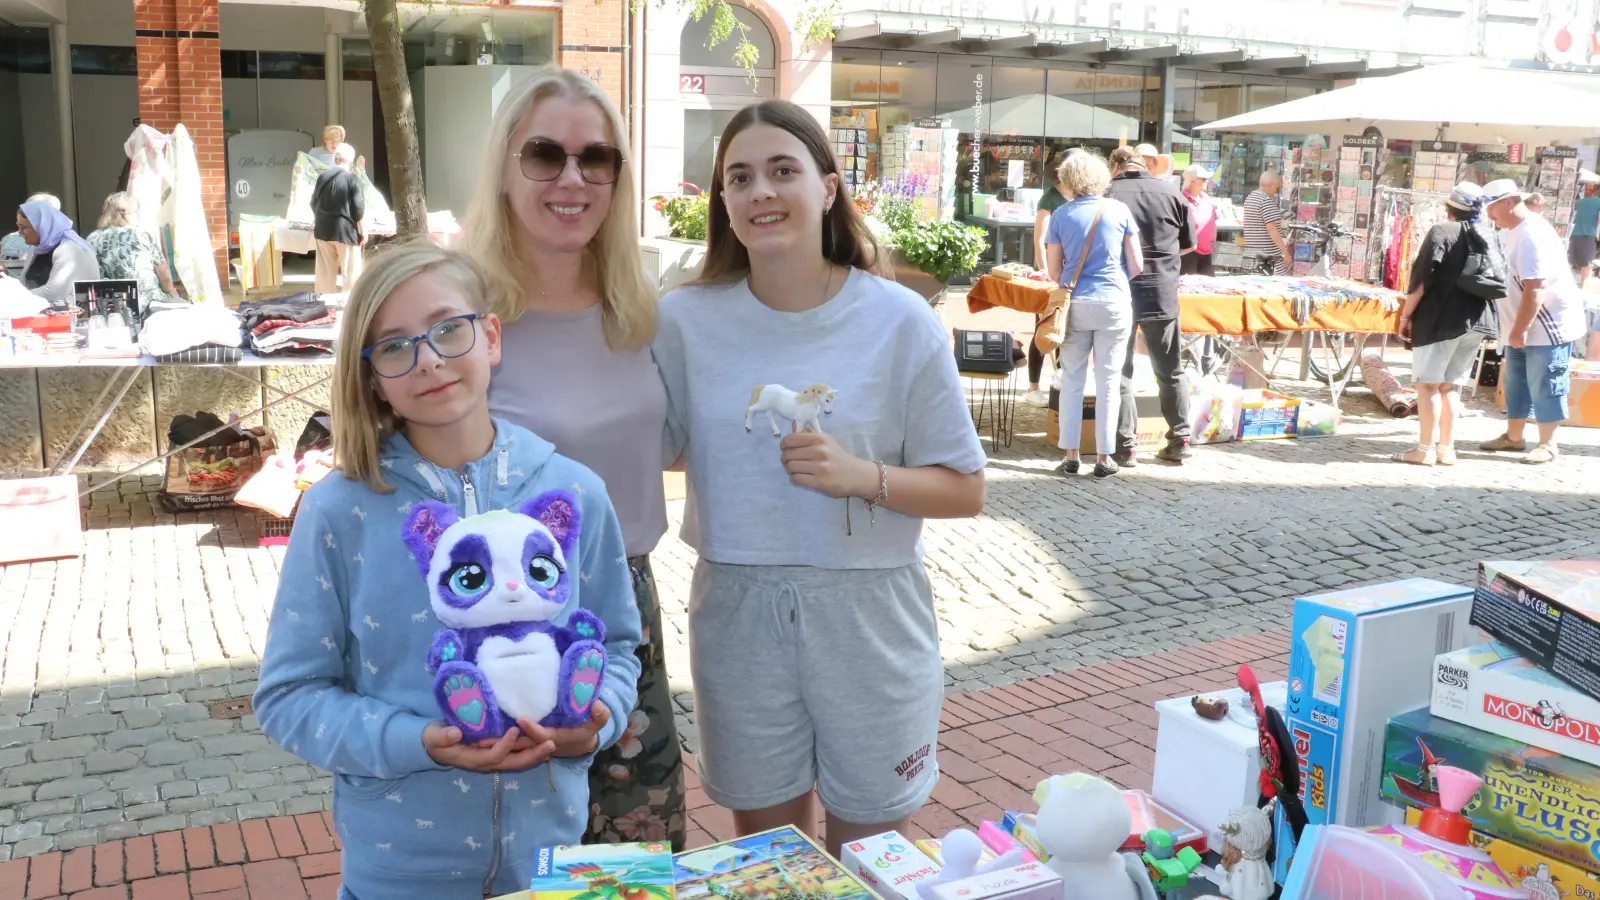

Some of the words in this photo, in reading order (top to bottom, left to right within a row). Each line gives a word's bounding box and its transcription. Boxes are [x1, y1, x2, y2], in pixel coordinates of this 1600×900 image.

[680, 76, 703, 92] 22
[970, 73, 983, 202] www.buecher-weber.de
[997, 145, 1034, 154] WEBER
[236, 182, 248, 196] 40
[1438, 664, 1468, 679] PARKER
[894, 744, 930, 776] BONJOUR
[1309, 762, 1326, 811] Kids
[1540, 780, 1574, 798] DER
[537, 848, 550, 876] KOSMOS
[980, 878, 1018, 890] Puzzle
[1576, 884, 1595, 900] Das
